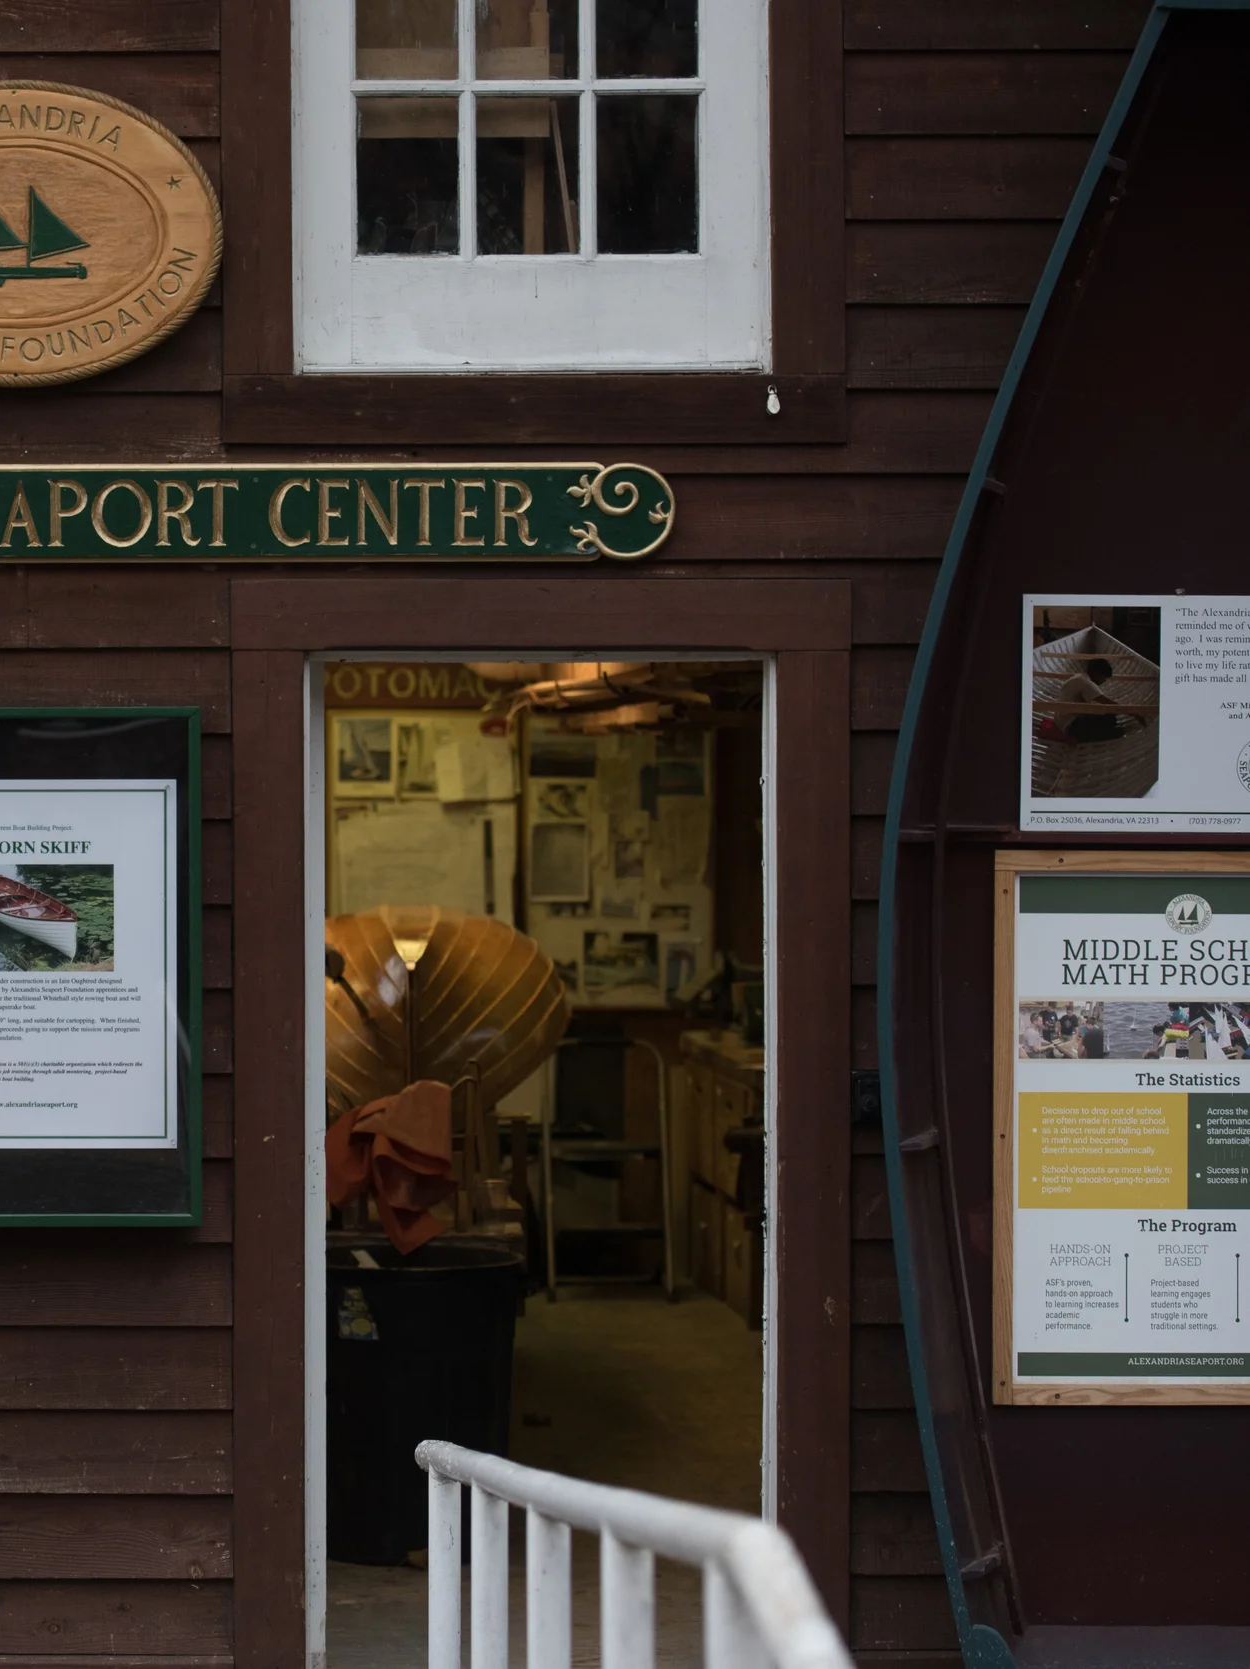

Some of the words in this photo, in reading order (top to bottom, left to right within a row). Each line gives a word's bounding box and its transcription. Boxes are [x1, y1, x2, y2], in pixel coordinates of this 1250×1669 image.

[0, 247, 198, 362] FOUNDATION
[268, 477, 539, 547] CENTER
[1175, 620, 1217, 630] reminded
[1175, 636, 1194, 645] ago.
[1199, 634, 1203, 643] I
[1175, 647, 1203, 657] worth,
[1206, 650, 1220, 659] my
[1186, 660, 1203, 669] live
[1205, 663, 1219, 672] my
[1222, 660, 1237, 670] life
[324, 666, 501, 699] OTOMAC
[1174, 673, 1190, 685] gift
[1192, 674, 1208, 683] has
[1210, 674, 1234, 683] made
[1235, 674, 1247, 683] all
[1030, 816, 1044, 824] P.O.
[1045, 816, 1059, 824] Box
[1060, 816, 1084, 824] 25036,
[1189, 817, 1207, 825] (703)
[40, 841, 91, 854] SKIFF
[1063, 939, 1178, 961] MIDDLE
[1190, 939, 1248, 961] SCH
[1062, 964, 1149, 985] MATH
[1135, 1072, 1165, 1086] The
[1169, 1073, 1240, 1086] Statistics
[1042, 1106, 1080, 1115] Decisions
[1136, 1106, 1162, 1115] school
[1206, 1107, 1234, 1115] Across
[1235, 1107, 1249, 1115] the
[1137, 1218, 1167, 1232] The
[1171, 1219, 1237, 1236] Program
[1050, 1244, 1111, 1254] HANDS-ON
[1158, 1244, 1209, 1255] PROJECT
[1049, 1256, 1111, 1267] APPROACH
[1164, 1256, 1202, 1267] BASED
[1066, 1280, 1093, 1288] proven,
[1150, 1279, 1199, 1289] Project-based
[1045, 1289, 1078, 1298] hands-on
[1080, 1289, 1113, 1299] approach
[1150, 1289, 1179, 1300] learning
[1180, 1291, 1211, 1300] engages
[1054, 1300, 1083, 1310] learning
[1085, 1300, 1119, 1309] increases
[1150, 1300, 1182, 1309] students
[1183, 1300, 1198, 1309] who
[1045, 1311, 1080, 1319] academic
[1045, 1321, 1093, 1331] performance.
[1127, 1357, 1244, 1365] ALEXANDRIASEAPORT.ORG
